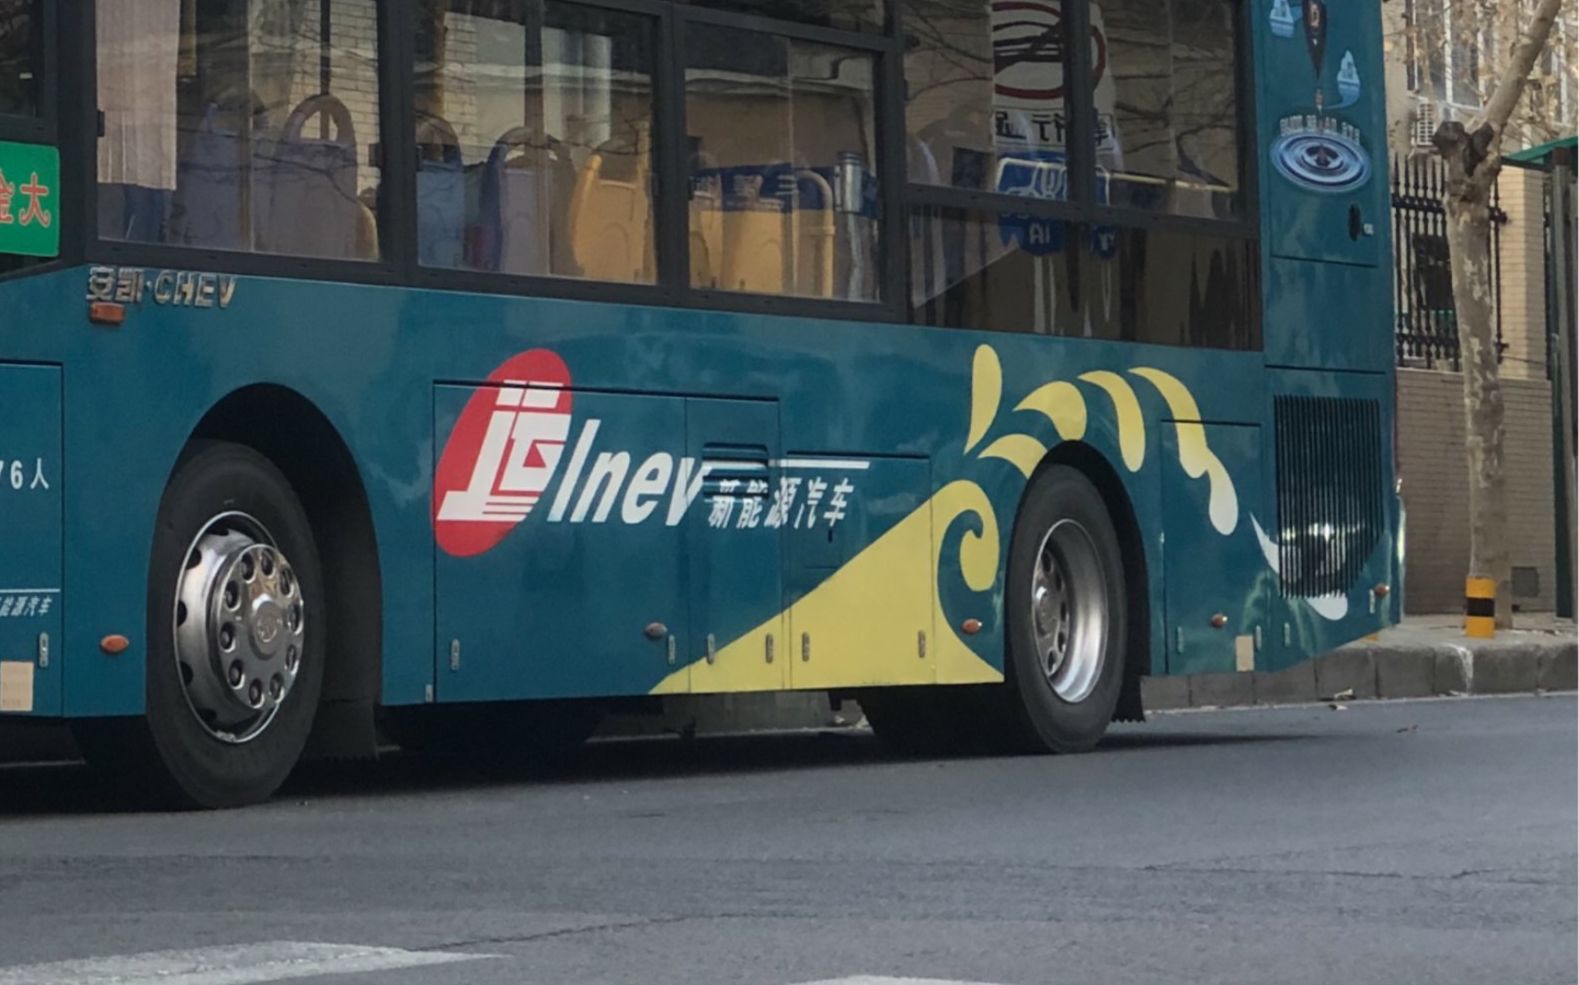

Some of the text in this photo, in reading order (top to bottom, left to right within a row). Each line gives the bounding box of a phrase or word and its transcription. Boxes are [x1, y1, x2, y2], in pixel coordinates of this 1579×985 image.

[707, 476, 854, 530] 新能源汽车
